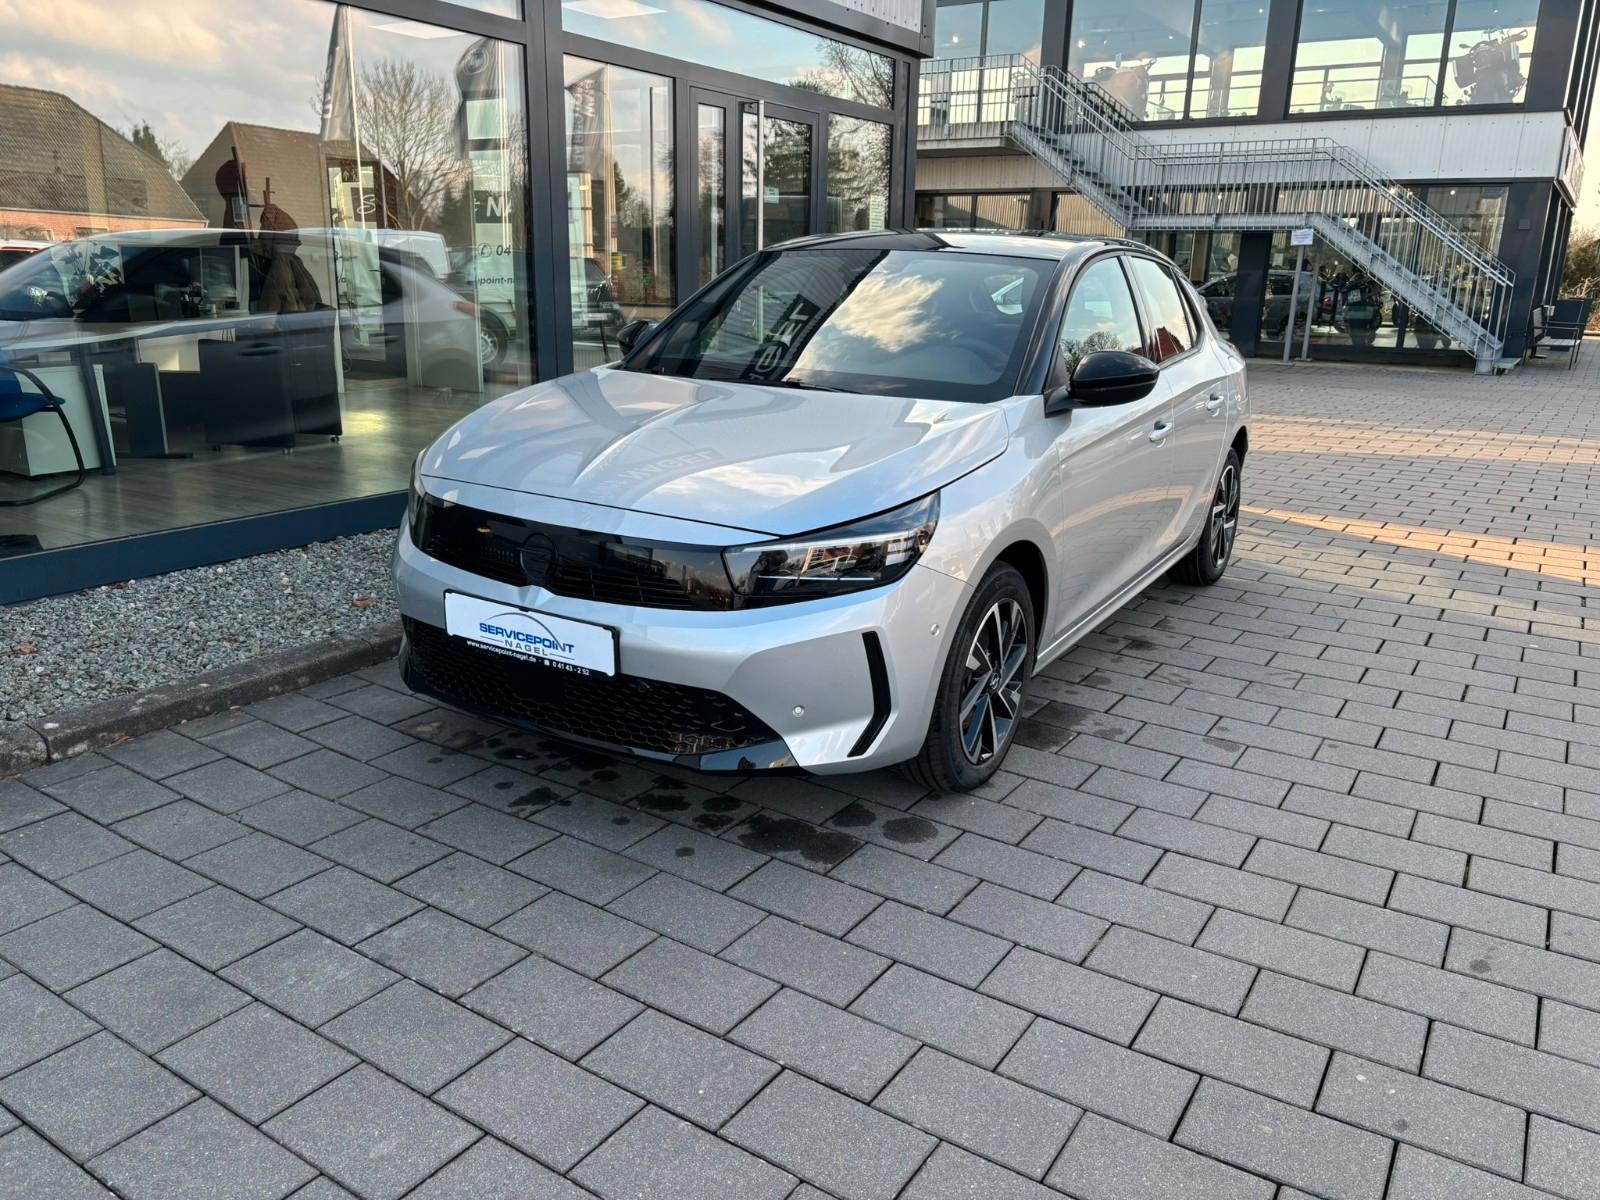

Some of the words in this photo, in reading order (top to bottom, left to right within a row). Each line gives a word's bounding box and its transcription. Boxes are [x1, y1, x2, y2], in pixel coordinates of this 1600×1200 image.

[479, 622, 575, 654] SERVICEPOINT
[504, 639, 549, 657] NAGEL
[466, 639, 537, 663] www.servicepoint-nagel.de
